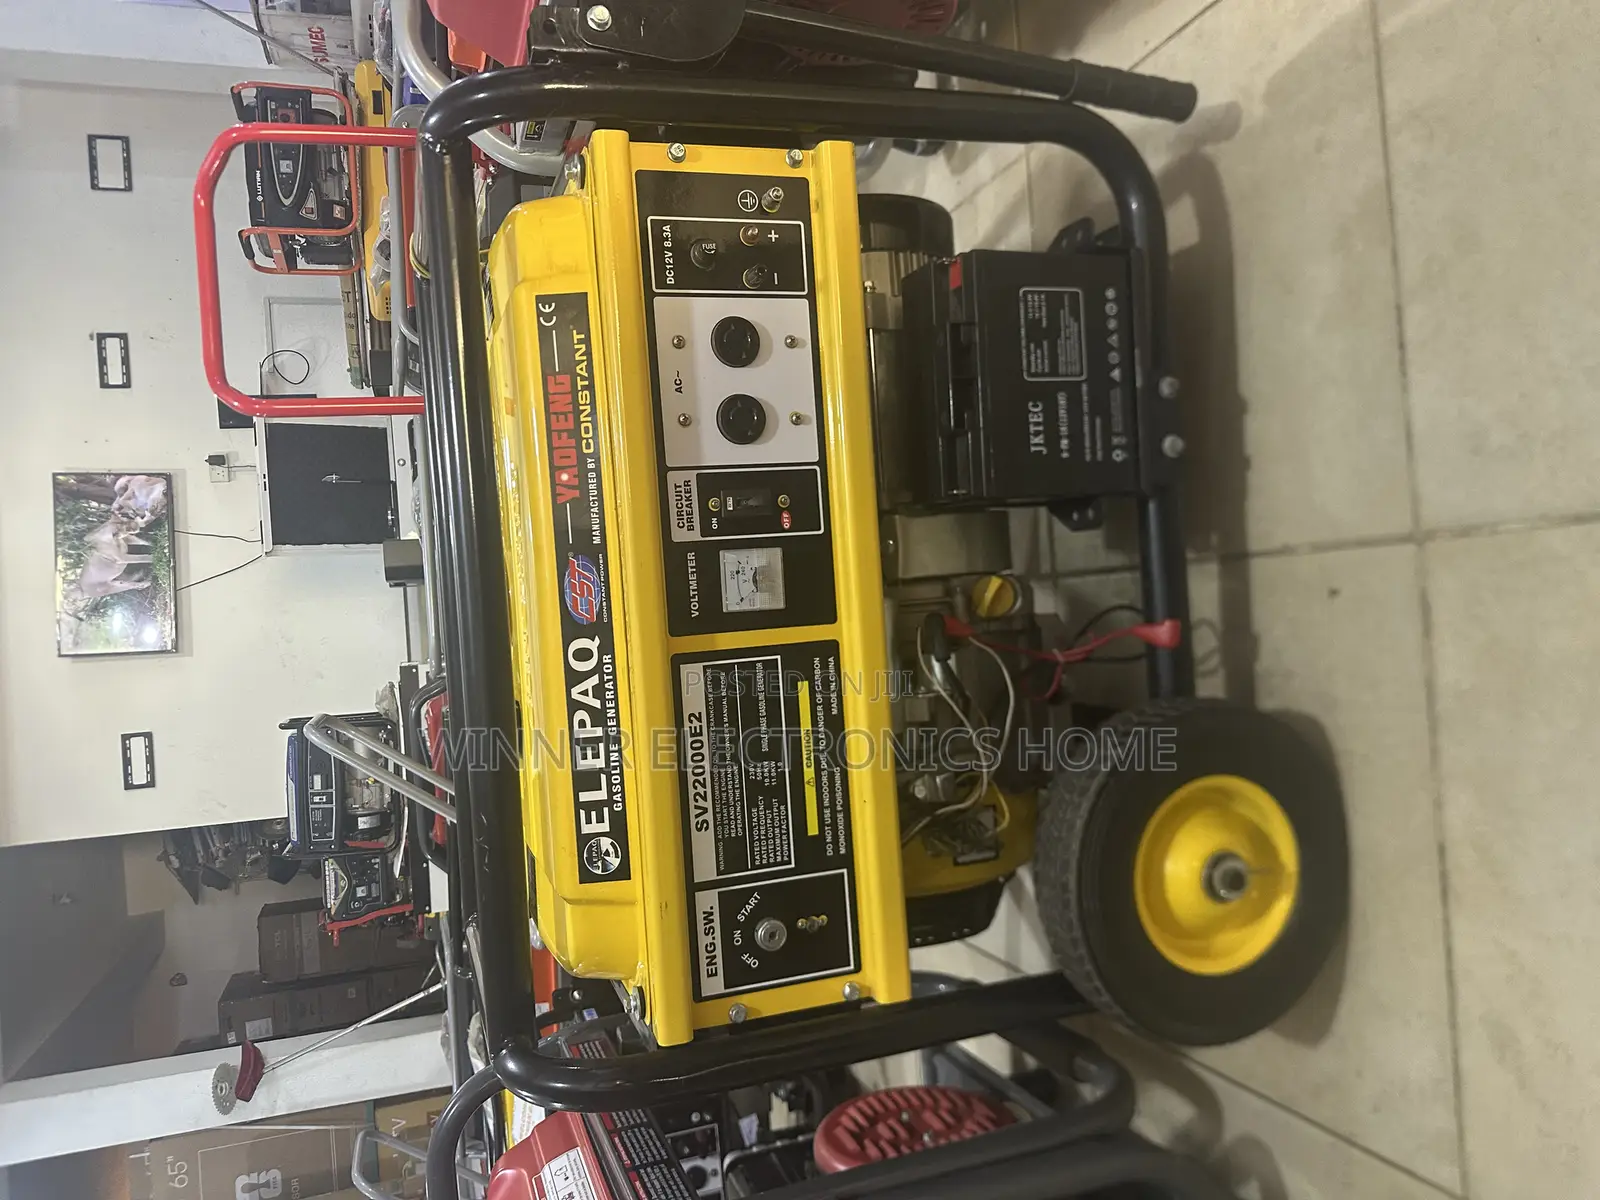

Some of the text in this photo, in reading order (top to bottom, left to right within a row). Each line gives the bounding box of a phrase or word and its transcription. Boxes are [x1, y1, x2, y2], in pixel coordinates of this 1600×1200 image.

[307, 26, 330, 63] SUMEC
[662, 224, 674, 284] DC12V 8.3A
[547, 374, 580, 504] YAOFENG
[573, 329, 601, 544] MANUFACTURED BY CONSTANT
[1028, 401, 1048, 455] JKTEC
[674, 482, 686, 529] CIRCUIT
[684, 480, 694, 532] BREAKER
[712, 518, 718, 530] ON
[568, 556, 597, 622] CST
[598, 553, 608, 623] CONSTANT POWER
[687, 552, 700, 618] VOLTMETER
[720, 698, 728, 722] MANUAL
[756, 662, 769, 752] SINGLE PHASE GASOLINE GENERATOR
[828, 656, 838, 714] MADE IN CHINA
[567, 635, 611, 834] ELEPAQ
[602, 654, 623, 812] GASOLINE GENERATOR
[708, 694, 716, 730] CRANKCASE
[688, 711, 710, 833] SV22000E2
[802, 728, 812, 768] CAUTION
[814, 657, 834, 856] DO NOT USE INDOORS DUE TO DANGER OF CARBON
[712, 764, 720, 812] RECOMMENDED
[726, 764, 734, 805] UNDERSTAND
[758, 796, 766, 839] FREQUENCY
[766, 810, 774, 838] OUTPUT
[772, 798, 780, 826] OUTPUT
[834, 766, 846, 854] MONOXIDE POISONING
[768, 838, 776, 862] RATED
[774, 828, 782, 862] MAXIMUM
[736, 892, 761, 922] START
[702, 905, 718, 978] ENG.SW.
[733, 930, 742, 946] ON
[741, 952, 759, 968] OFF
